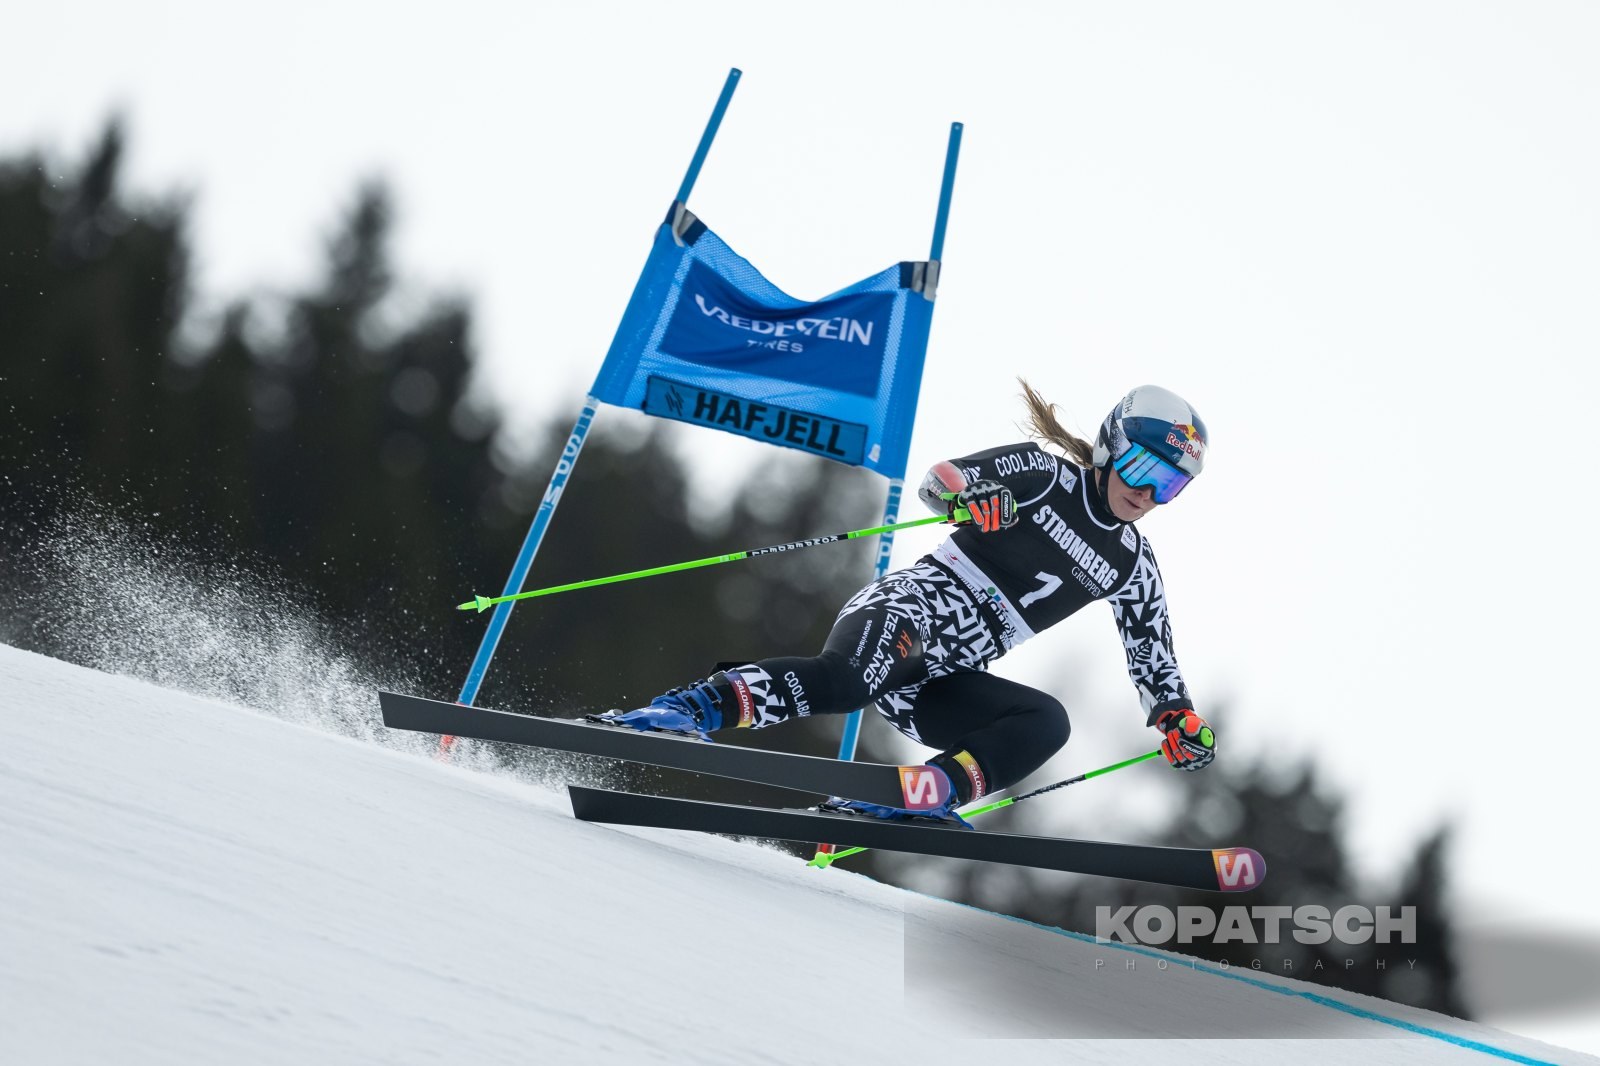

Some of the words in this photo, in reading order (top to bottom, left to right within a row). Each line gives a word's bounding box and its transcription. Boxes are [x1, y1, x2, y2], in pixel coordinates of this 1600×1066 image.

[746, 339, 803, 354] TRES
[693, 392, 846, 457] HAFJELL
[1165, 432, 1186, 451] Red
[1186, 445, 1202, 461] Bull
[751, 535, 839, 557] KOMPERDELL
[1032, 504, 1119, 591] STRØMBERG
[1071, 566, 1104, 598] GRUPPEN
[855, 619, 873, 657] snowvision
[863, 612, 899, 684] ZEALAND
[784, 671, 811, 718] COOLABA
[869, 653, 895, 695] NEW
[734, 679, 750, 722] SALOMON
